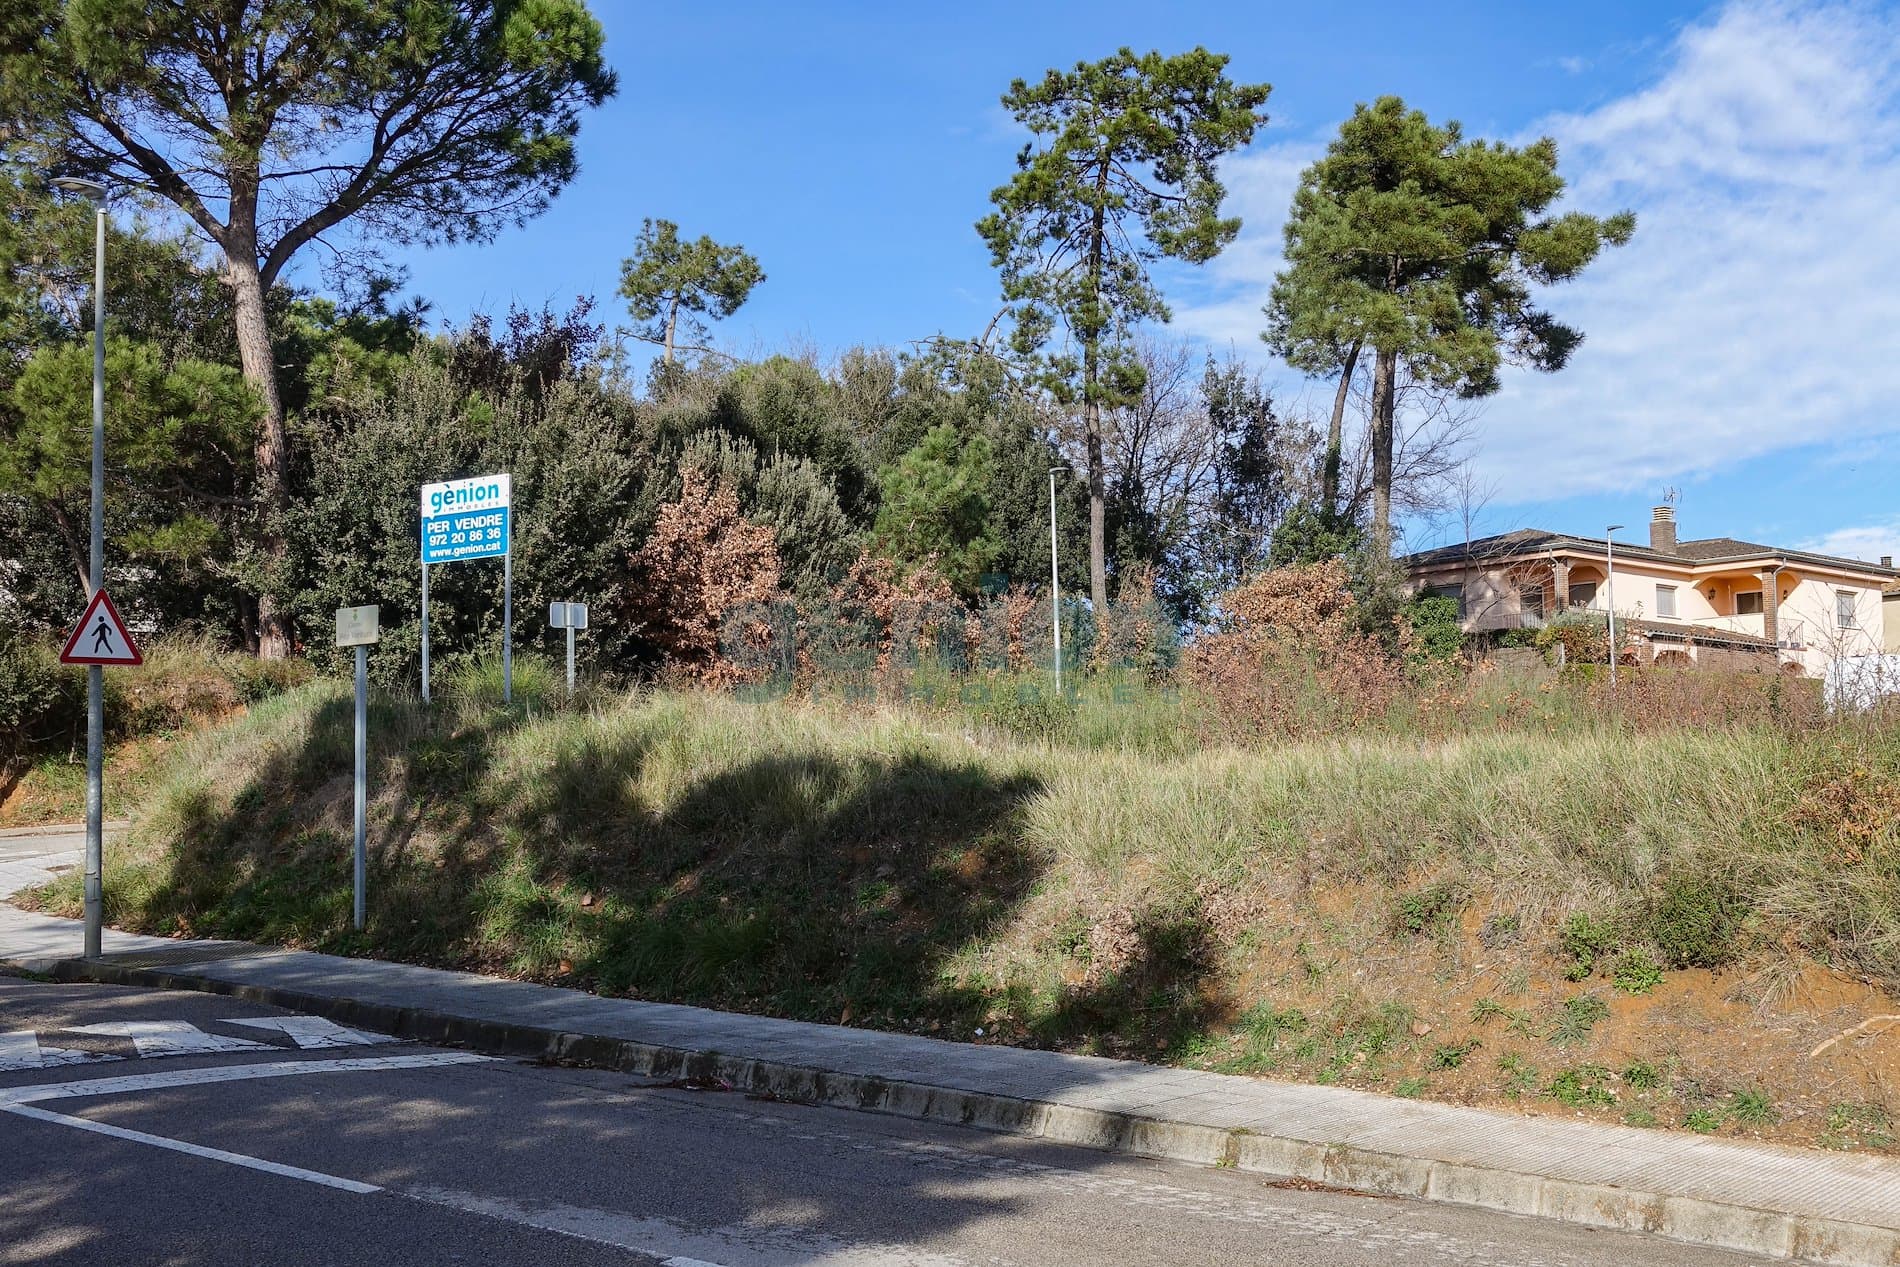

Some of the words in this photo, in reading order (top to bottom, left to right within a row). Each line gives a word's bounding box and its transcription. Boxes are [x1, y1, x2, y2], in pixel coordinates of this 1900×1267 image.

[427, 520, 450, 534] PER
[455, 513, 504, 530] VENDRE
[429, 534, 447, 546] 972
[451, 532, 465, 544] 20
[469, 530, 483, 542] 86
[486, 528, 501, 539] 36
[429, 541, 501, 558] www.genion.cat
